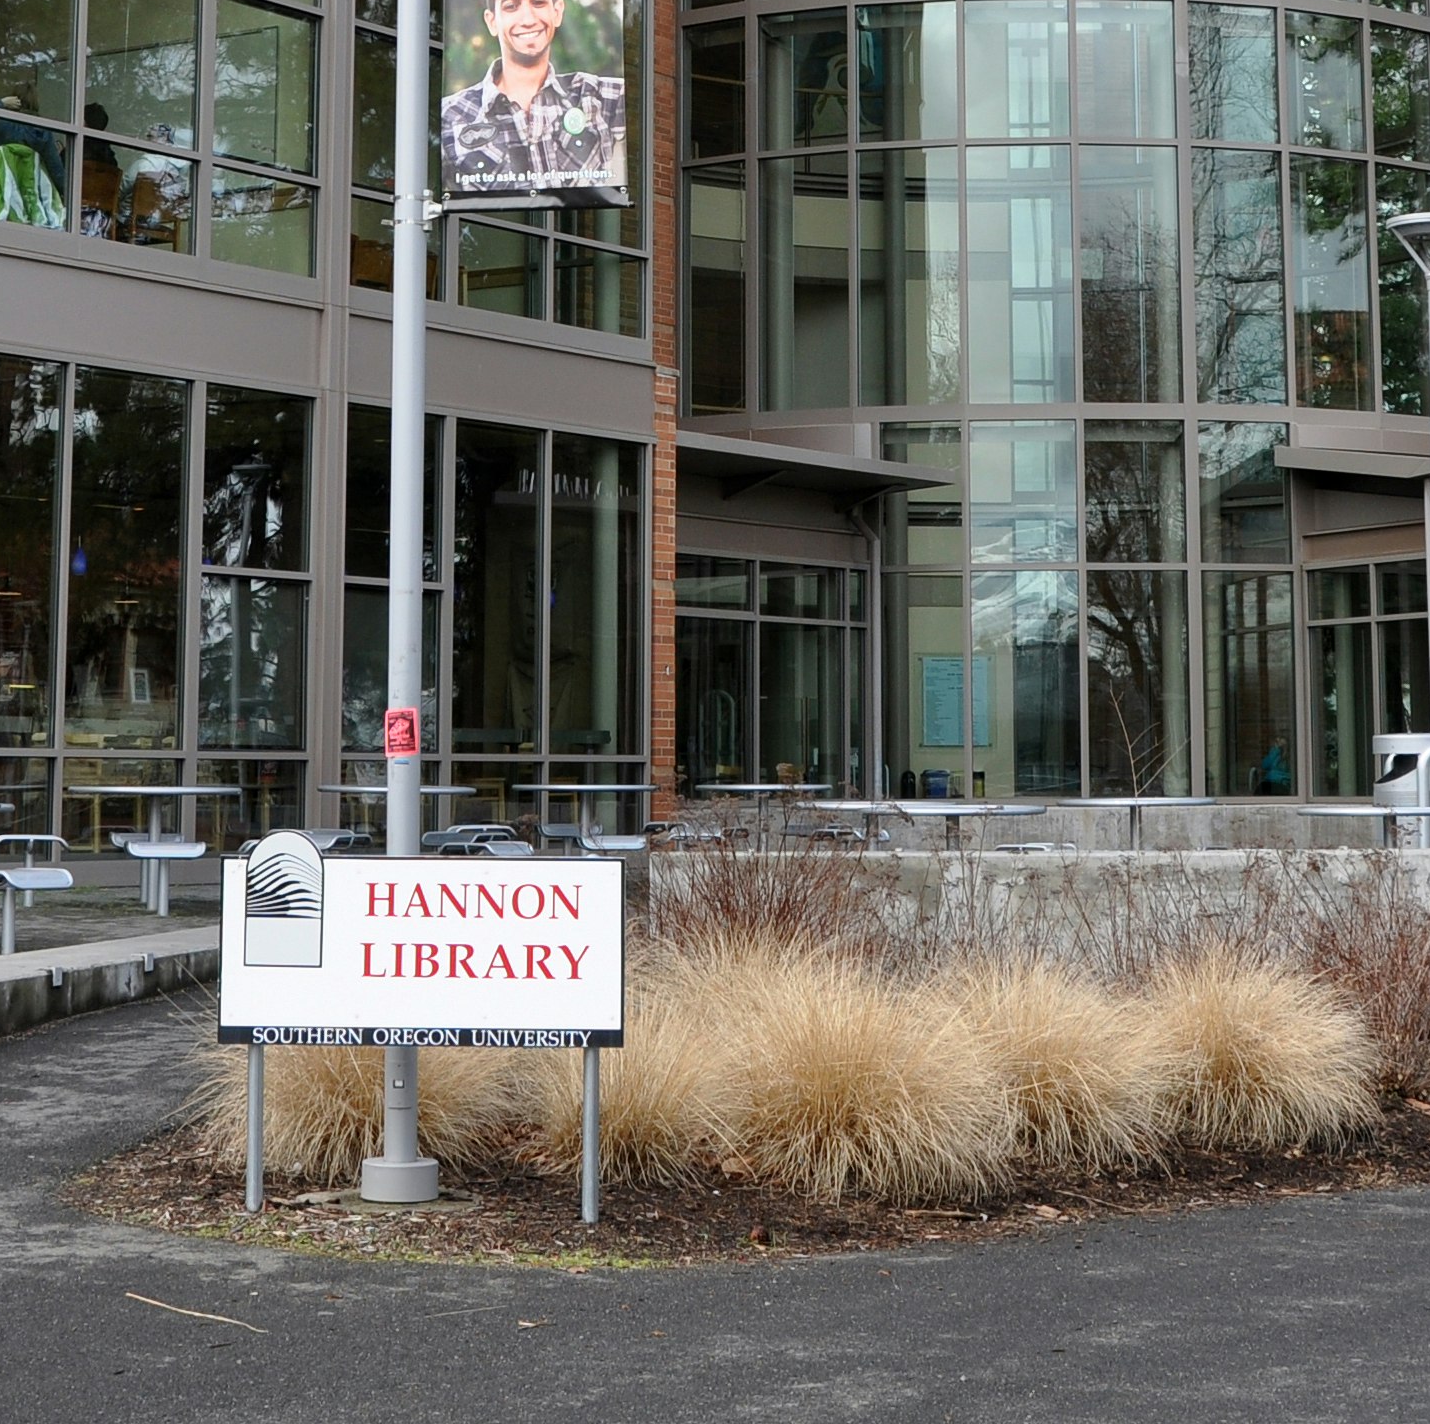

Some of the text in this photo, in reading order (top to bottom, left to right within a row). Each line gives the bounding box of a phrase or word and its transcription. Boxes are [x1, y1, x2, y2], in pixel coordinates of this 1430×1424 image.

[455, 173, 460, 184] I
[461, 172, 481, 186] get
[482, 172, 495, 183] to
[496, 170, 517, 182] ask
[517, 172, 526, 182] a
[527, 170, 542, 181] lot
[544, 169, 557, 181] of
[365, 882, 583, 921] HANNON
[360, 942, 590, 980] LIBRARY
[252, 1027, 592, 1048] SOUTHERN OREGON UNIVERSITY
